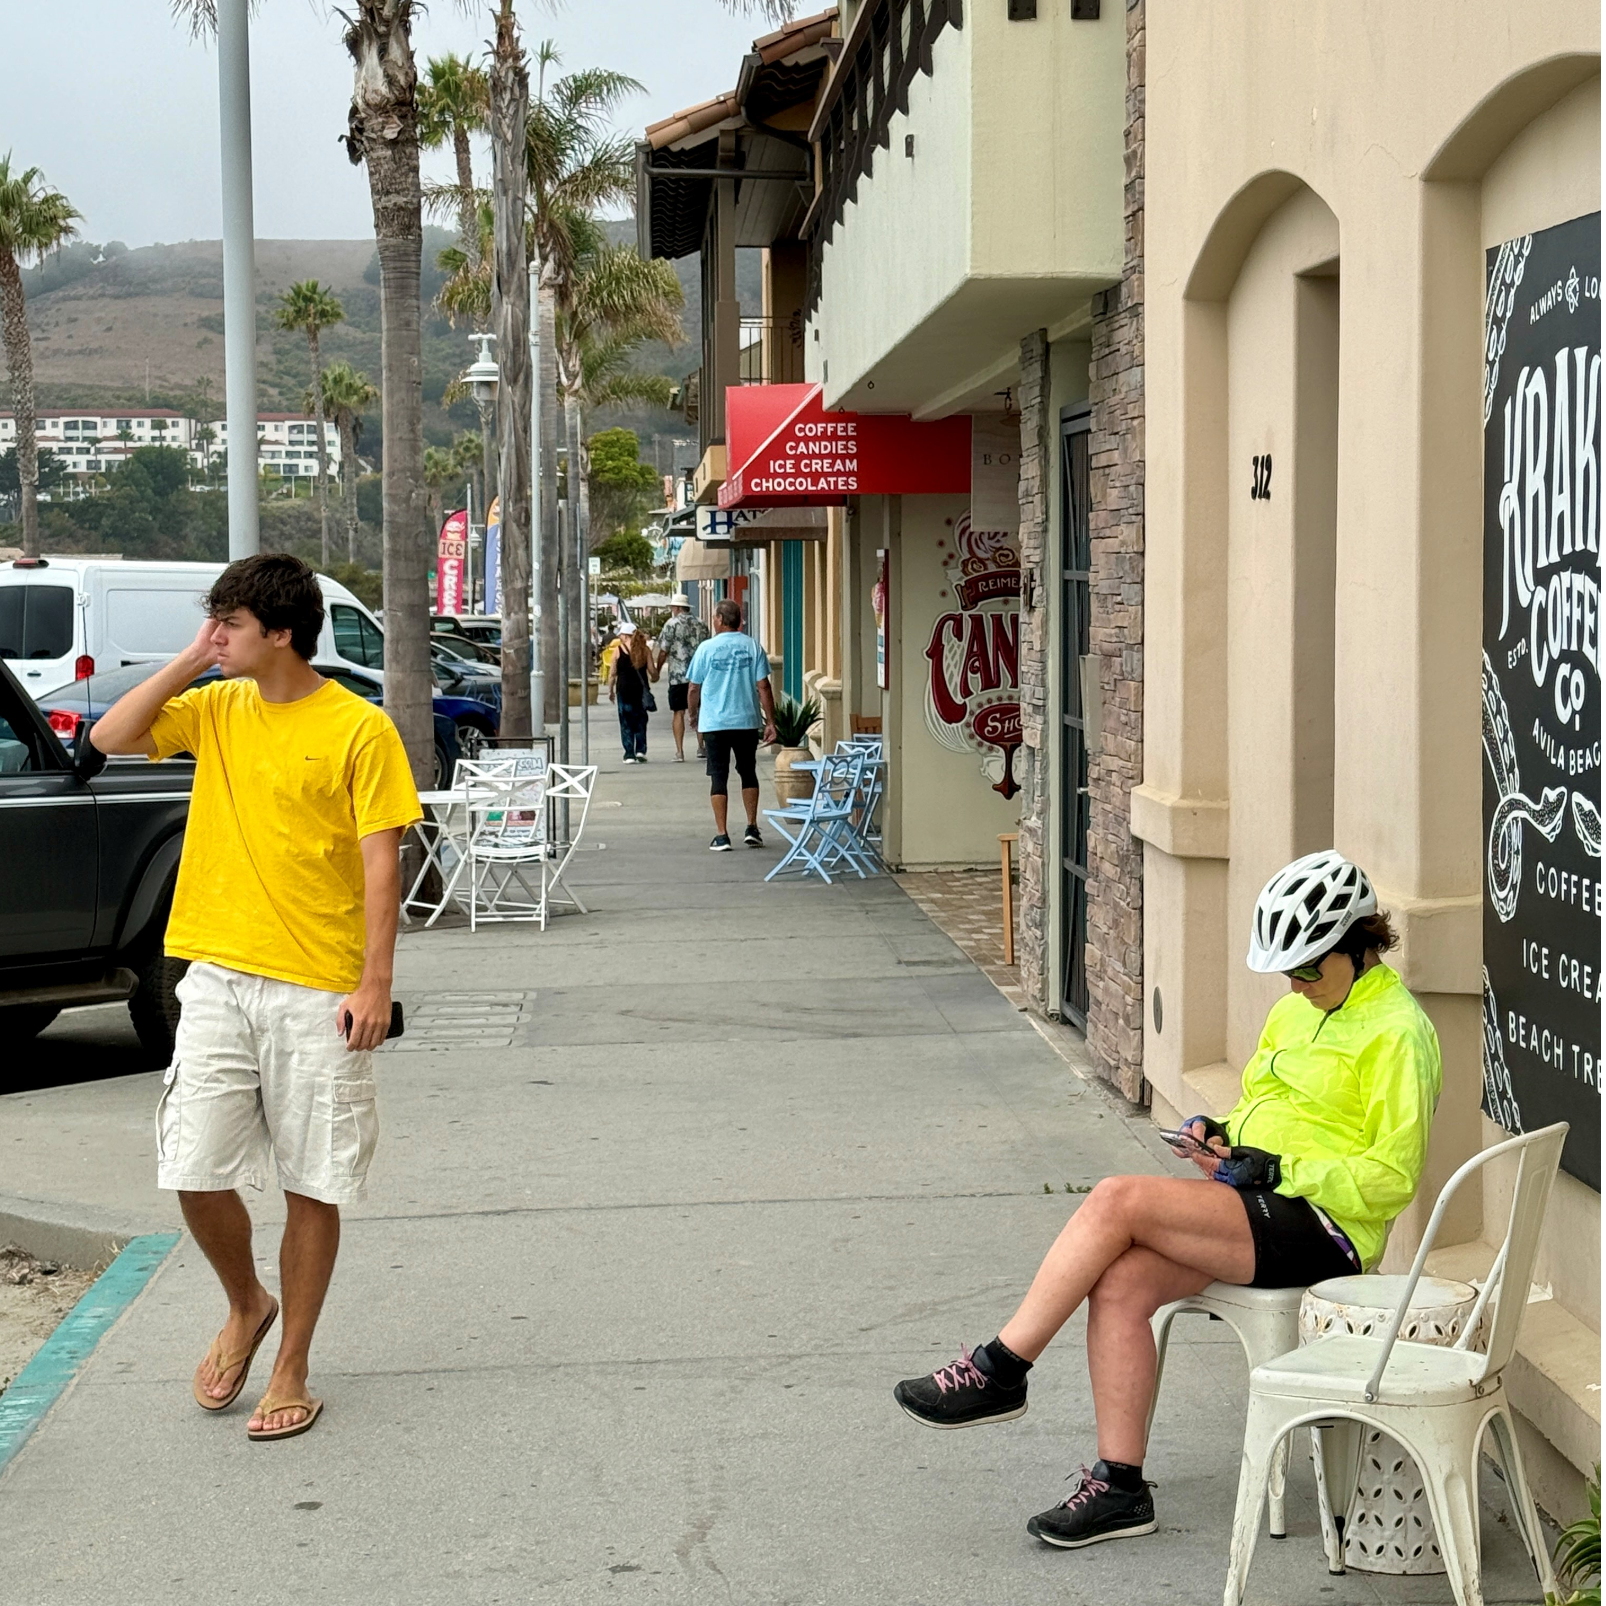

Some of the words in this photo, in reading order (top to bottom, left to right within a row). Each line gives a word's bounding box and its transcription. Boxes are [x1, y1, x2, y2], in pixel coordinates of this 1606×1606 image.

[1529, 279, 1563, 326] ALWAYS
[1584, 275, 1601, 300] LO
[794, 422, 857, 437] COFFEE
[785, 440, 858, 455] CANDIES
[769, 459, 796, 473] ICE
[800, 458, 858, 473] CREAM
[1250, 453, 1272, 501] 312
[750, 476, 858, 492] CHOCOLATES
[1499, 345, 1601, 642] KRAK
[702, 508, 769, 535] HAT
[441, 541, 463, 556] ICE
[978, 577, 1021, 593] REIME
[1532, 717, 1565, 771] AVILA
[1523, 938, 1550, 980] ICE
[1508, 1010, 1563, 1071] BEACH
[1255, 1194, 1271, 1219] TERRY
